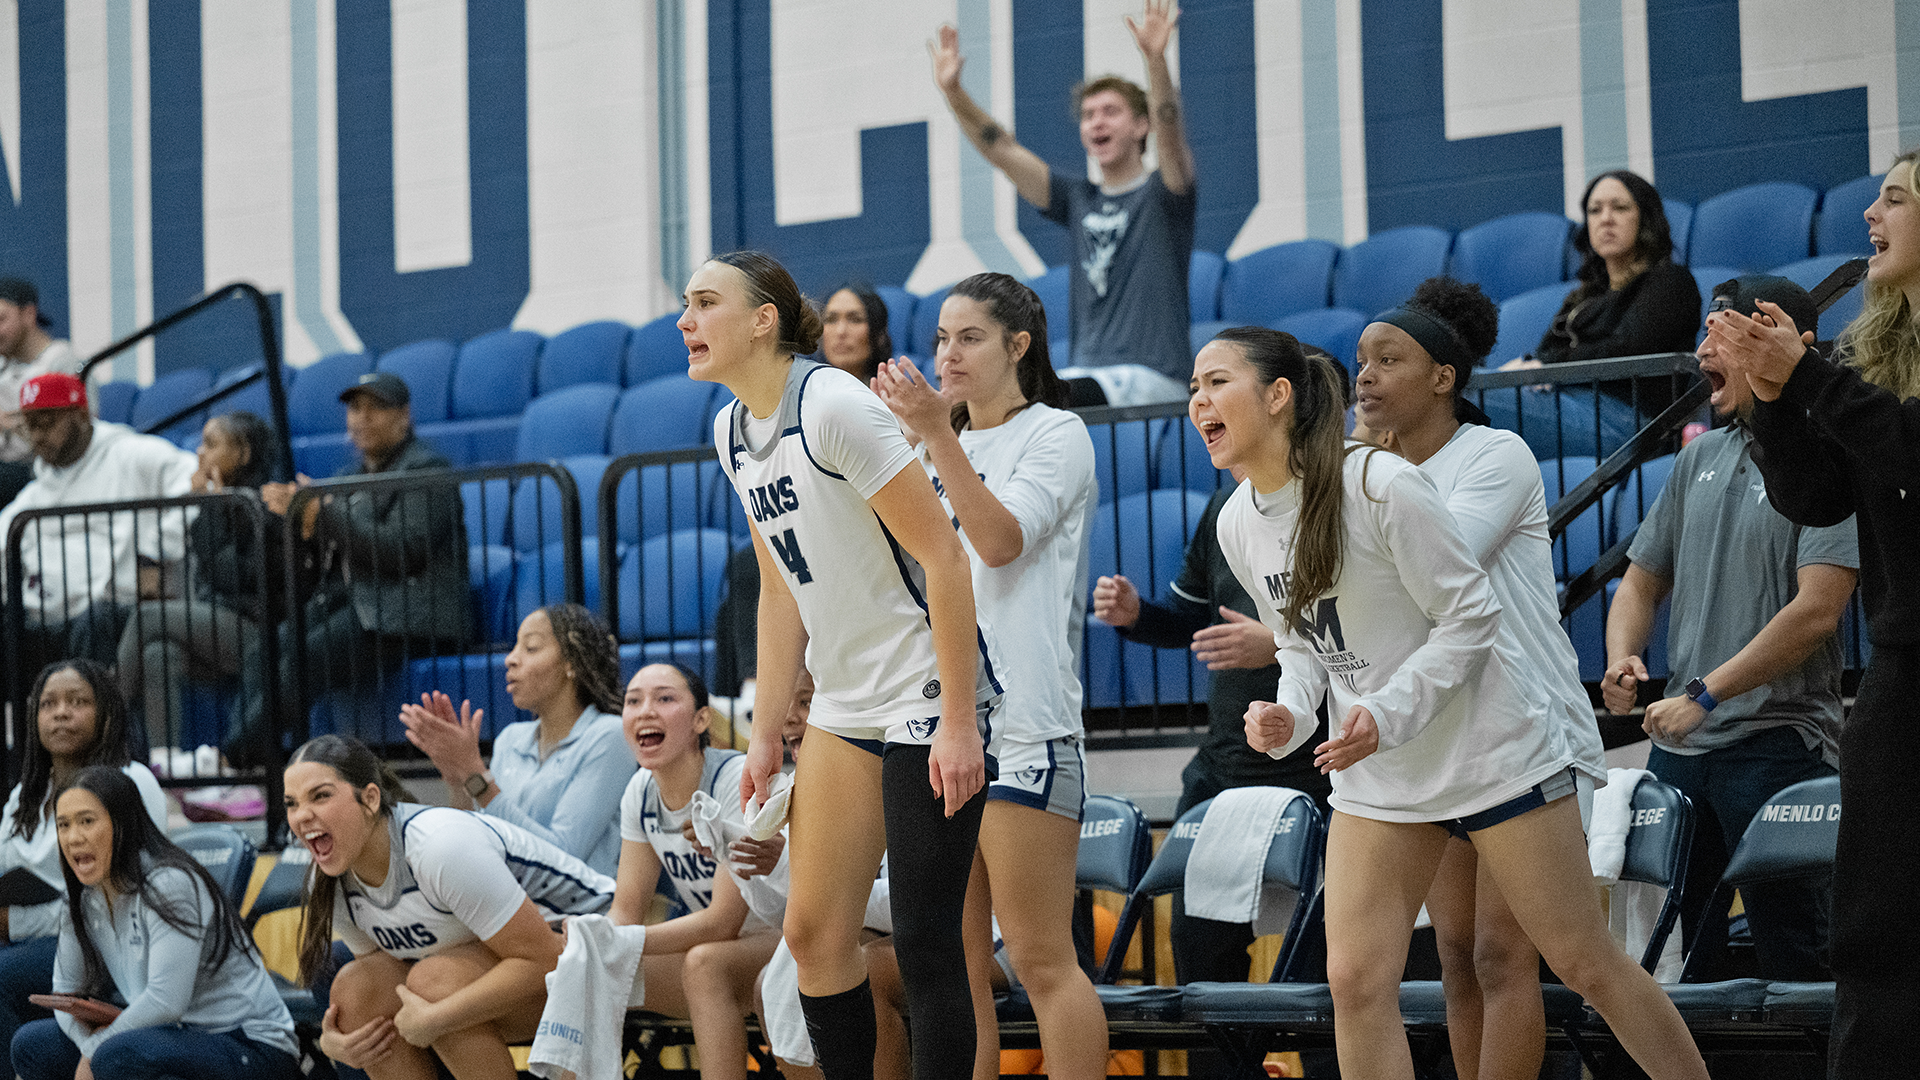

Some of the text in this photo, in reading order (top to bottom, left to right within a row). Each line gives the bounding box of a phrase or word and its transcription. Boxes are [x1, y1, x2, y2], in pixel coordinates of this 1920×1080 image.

[748, 475, 800, 523] OAKS
[1324, 659, 1370, 673] KETBALL
[1630, 807, 1667, 827] LEGE
[1761, 804, 1825, 822] MENLO
[1080, 818, 1125, 838] LLEGE
[664, 851, 718, 881] OAKS
[372, 922, 438, 950] OAKS
